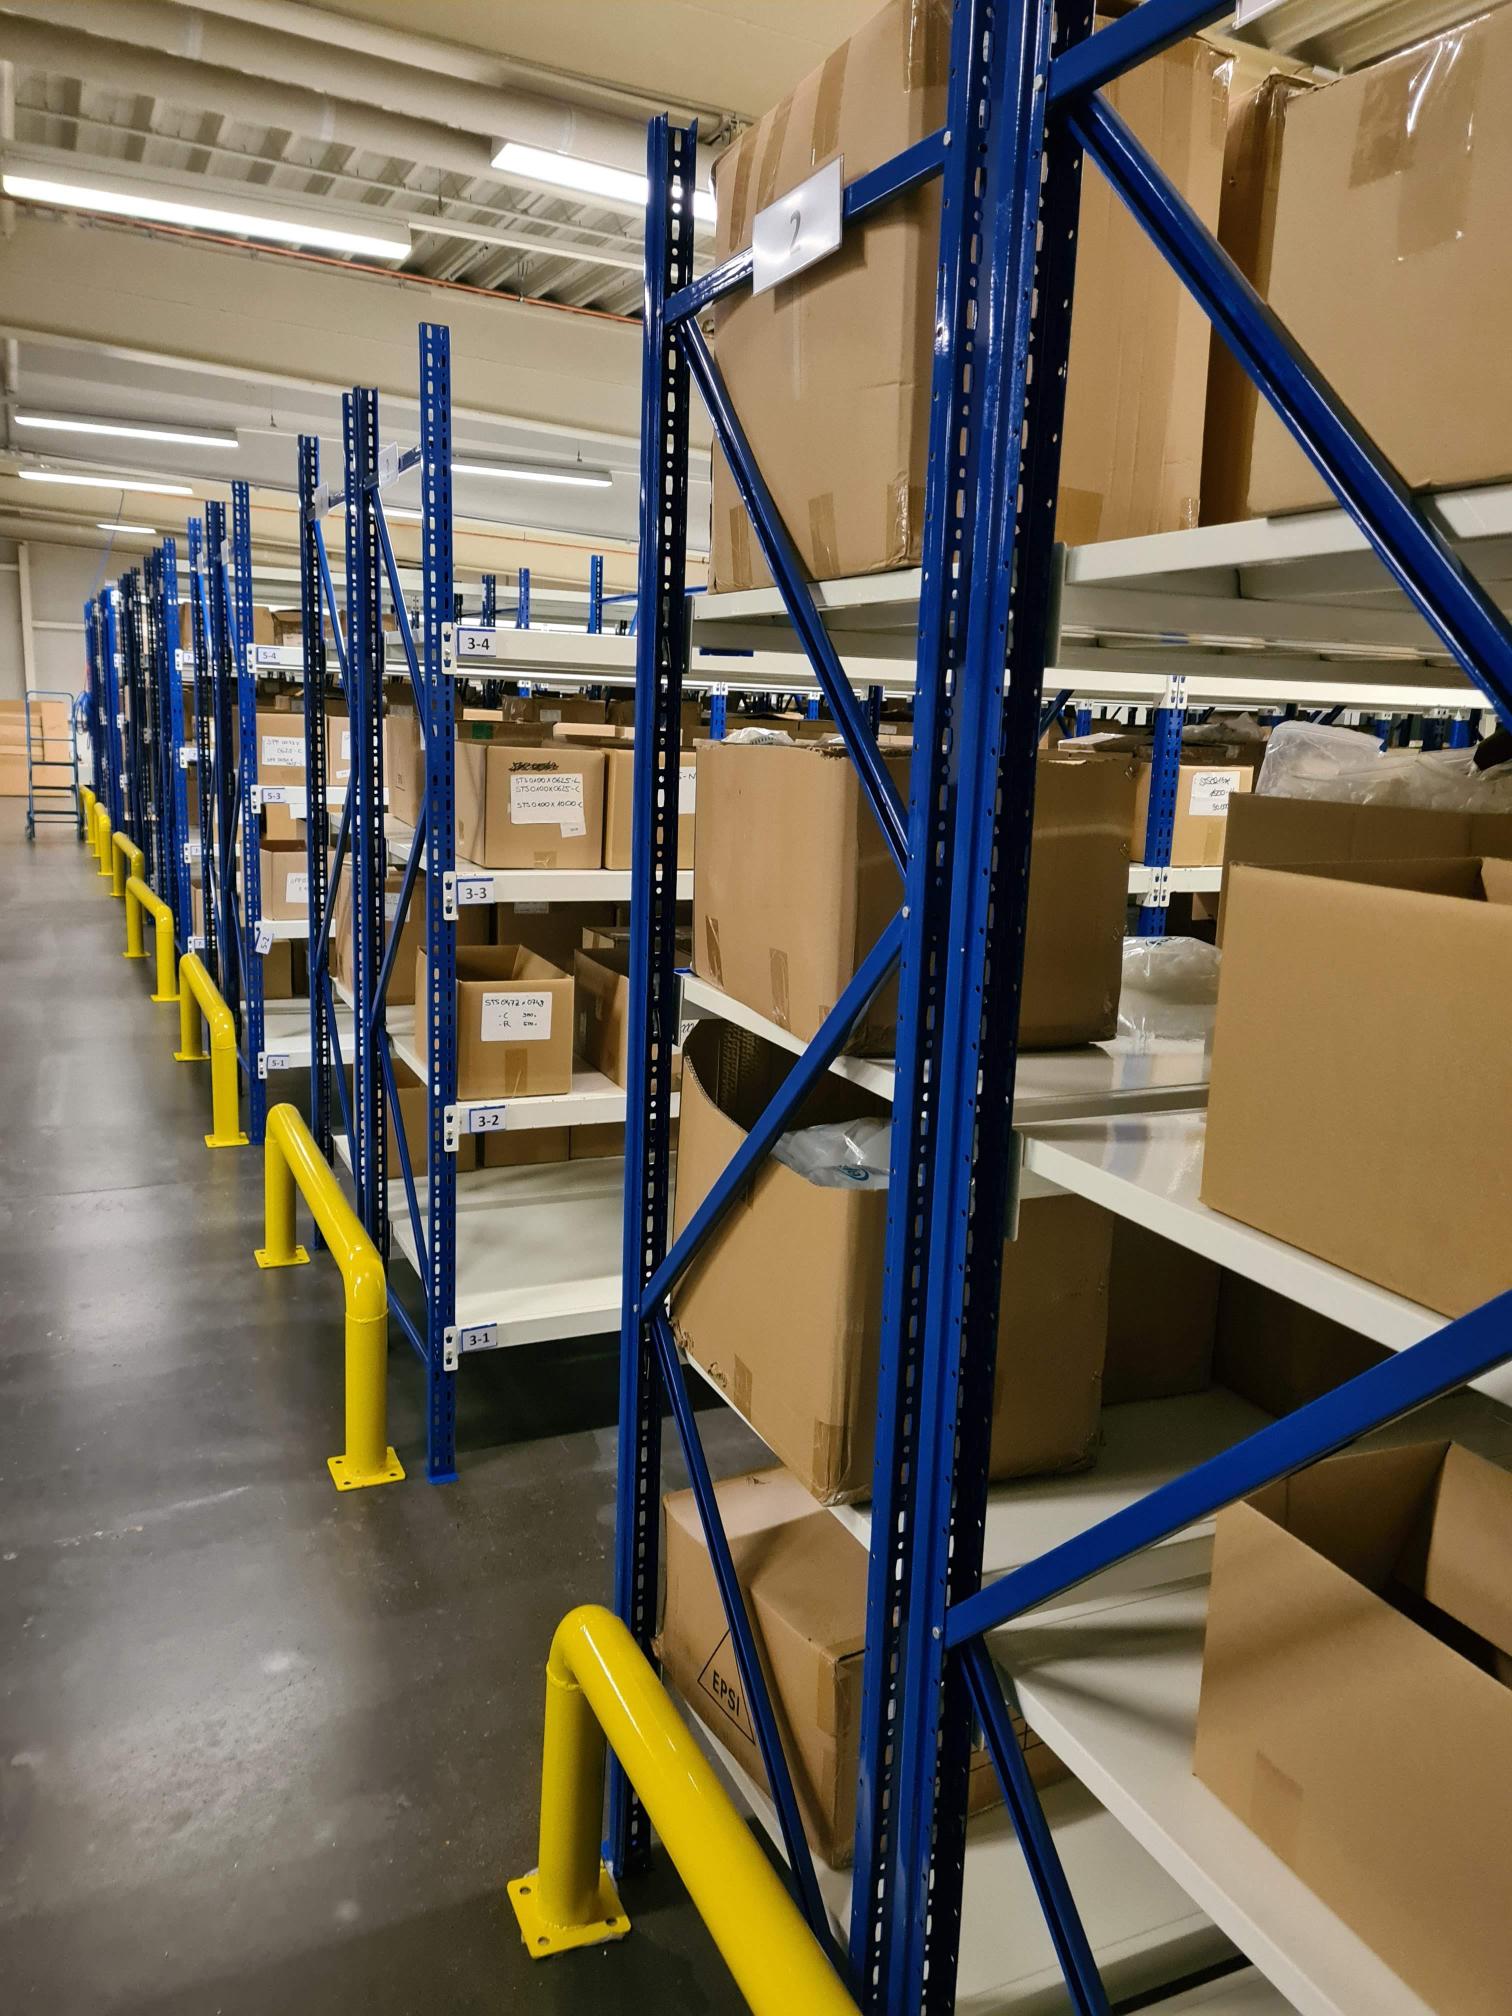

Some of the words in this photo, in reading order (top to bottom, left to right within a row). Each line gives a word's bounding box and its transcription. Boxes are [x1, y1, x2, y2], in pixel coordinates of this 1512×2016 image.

[467, 637, 490, 650] 3-4
[262, 651, 277, 659] 5-4
[267, 792, 281, 800] 5-3
[465, 887, 487, 899] 3-3
[260, 936, 270, 949] 5-2
[271, 1059, 285, 1067] 5-1
[478, 1114, 500, 1127] 3-2
[469, 1332, 490, 1346] 3-1
[712, 1669, 740, 1717] EPSI
